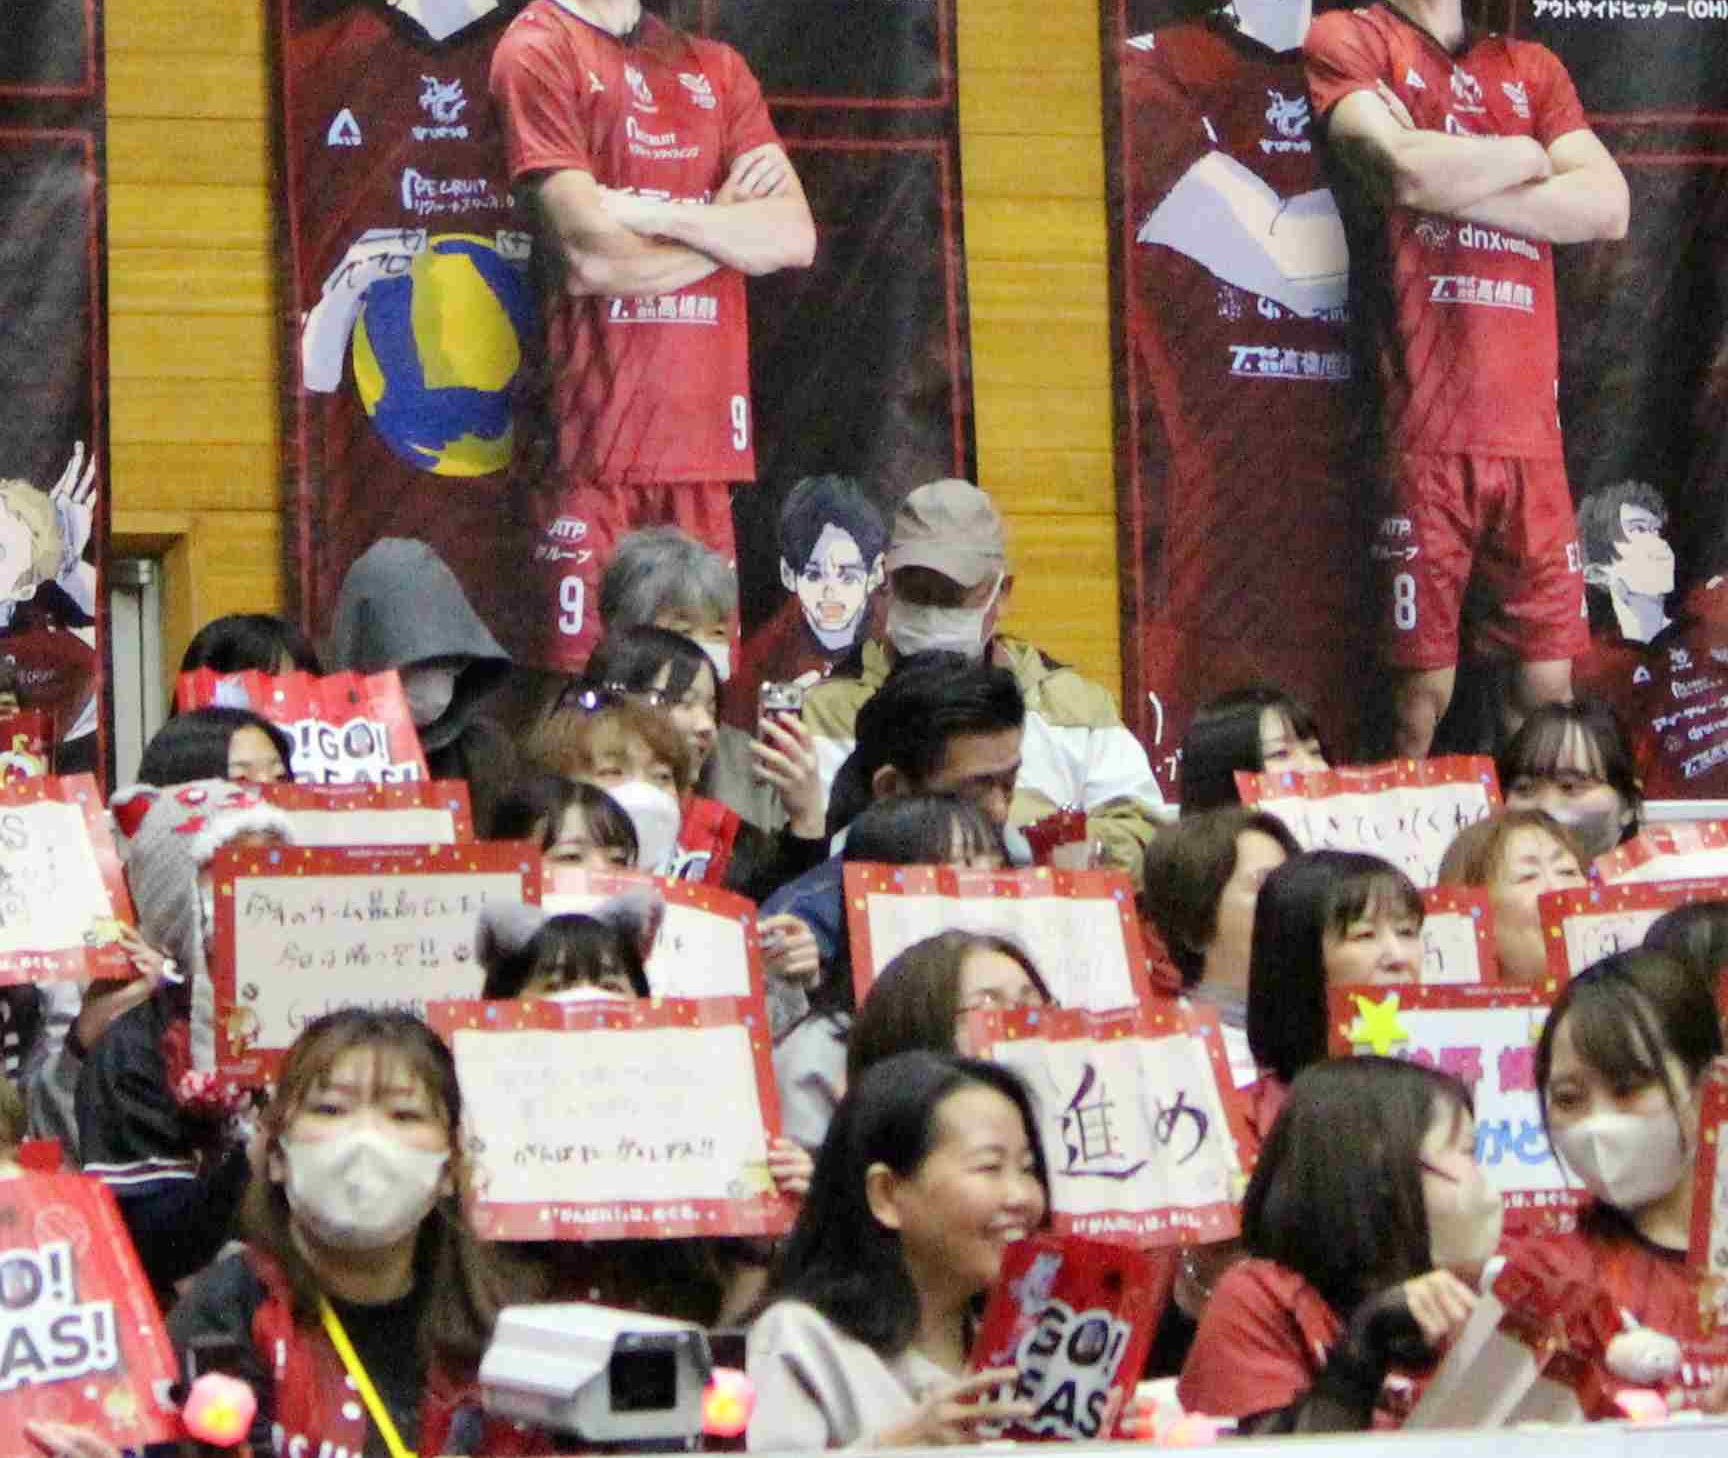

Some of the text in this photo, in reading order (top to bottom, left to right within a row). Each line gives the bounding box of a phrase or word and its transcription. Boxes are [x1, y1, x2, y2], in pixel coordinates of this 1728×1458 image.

[731, 395, 748, 451] 9
[550, 521, 587, 541] ATP
[559, 575, 585, 635] 9
[1393, 573, 1417, 631] 8
[1056, 1063, 1210, 1180] 進め
